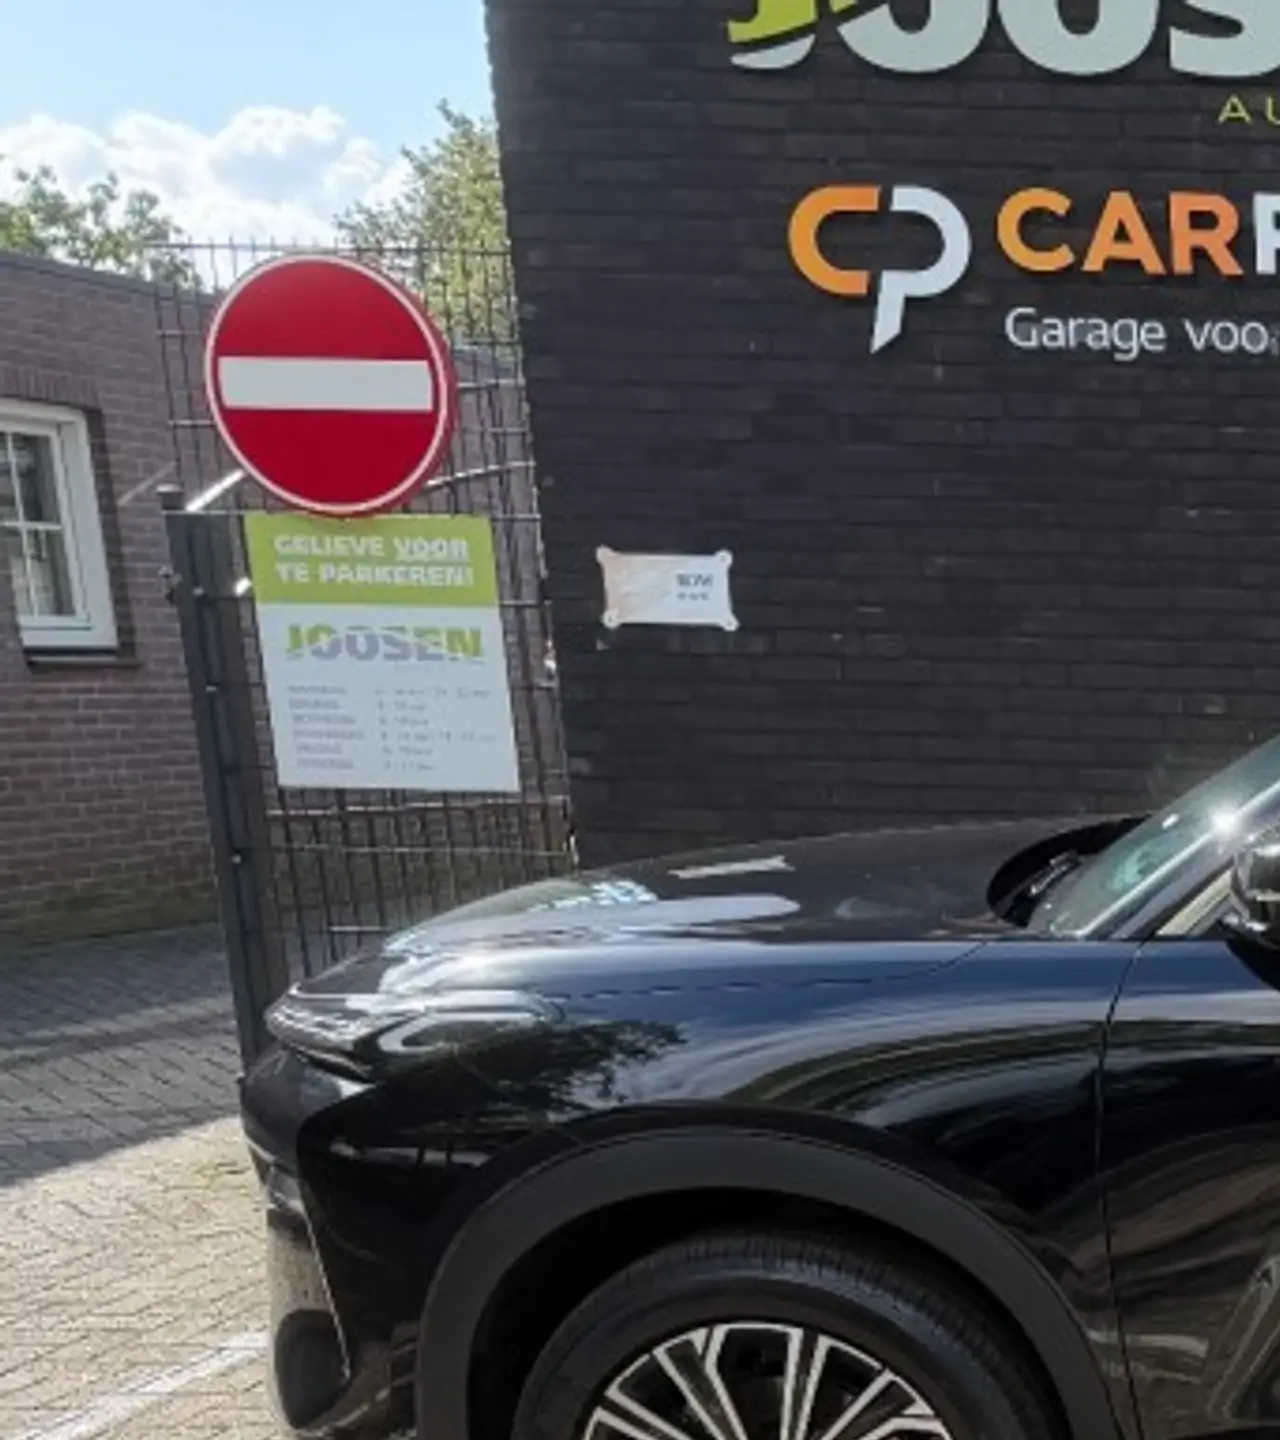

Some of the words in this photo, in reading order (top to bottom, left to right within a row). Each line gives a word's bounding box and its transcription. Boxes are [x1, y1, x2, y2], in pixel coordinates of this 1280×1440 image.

[1004, 305, 1166, 362] Garage
[274, 534, 385, 556] GELIEVE
[394, 536, 471, 561] VOOR
[275, 562, 311, 584] TE
[285, 623, 485, 665] JOOSEN
